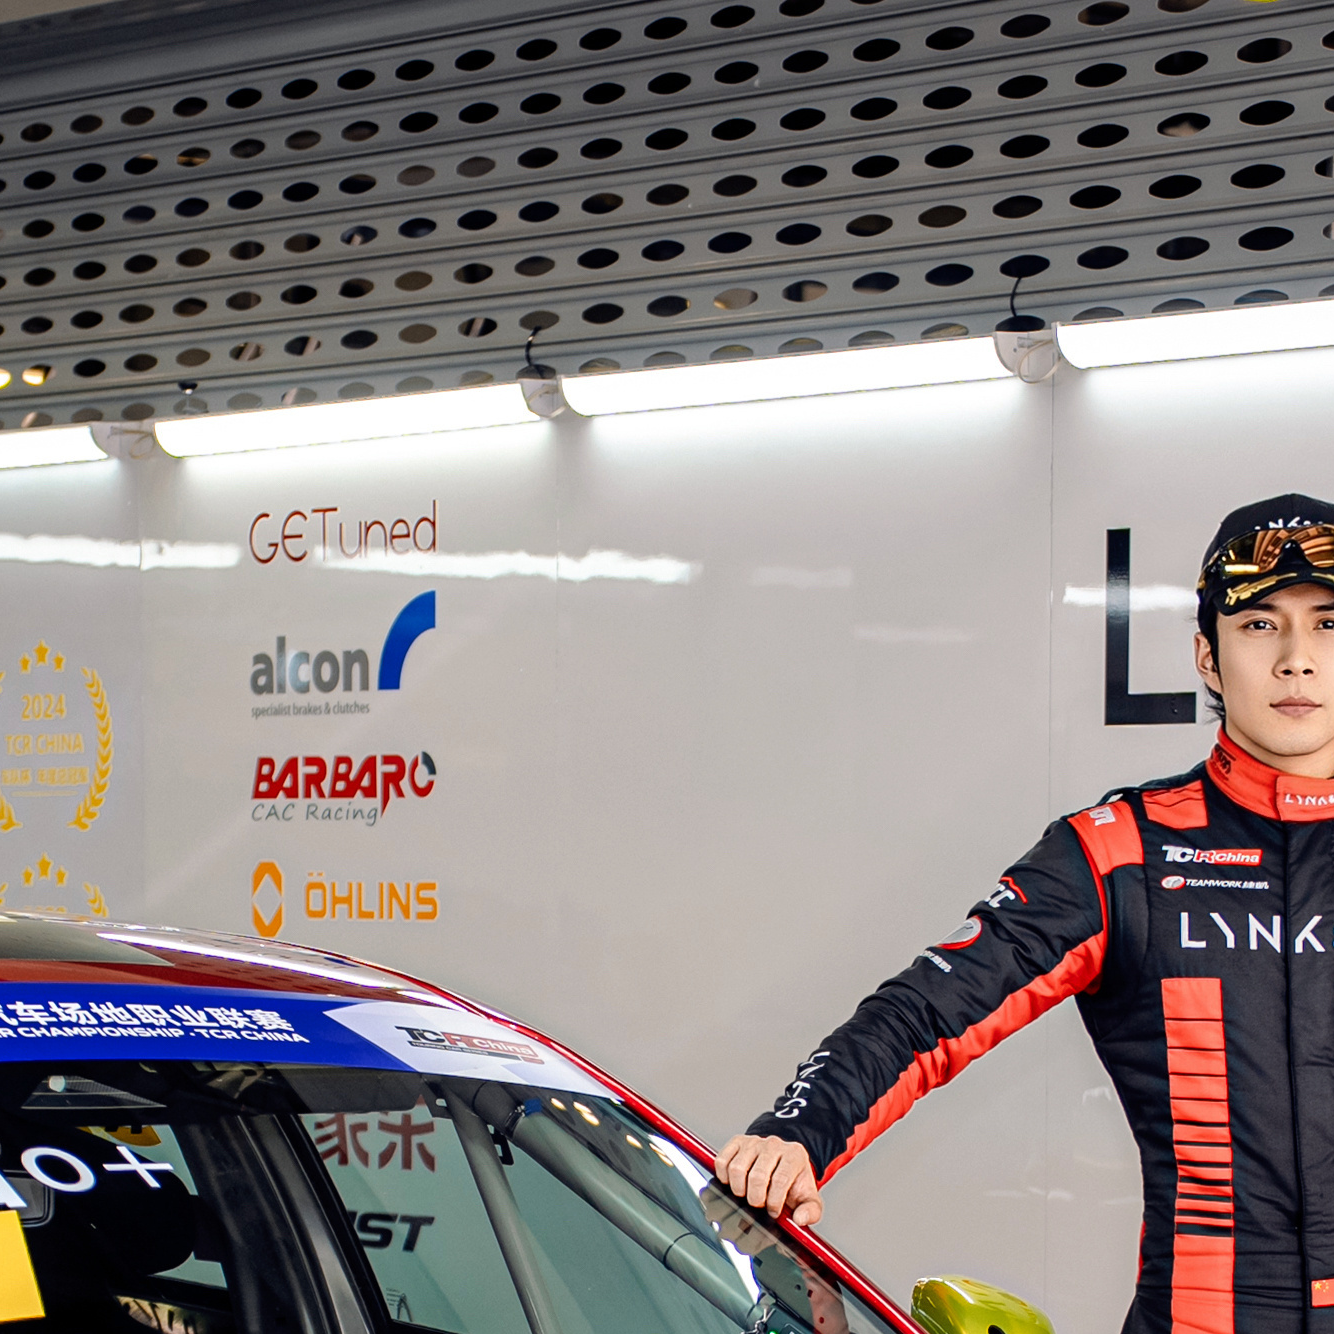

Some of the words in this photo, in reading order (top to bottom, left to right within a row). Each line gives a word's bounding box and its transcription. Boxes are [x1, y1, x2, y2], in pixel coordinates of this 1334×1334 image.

[249, 499, 437, 564] GETuned
[249, 635, 370, 696] alcon
[21, 693, 65, 721] 2024
[250, 702, 290, 719] specialist
[292, 701, 322, 716] brakes
[333, 700, 370, 715] clutches
[4, 734, 33, 757] TCR
[36, 732, 85, 755] CHINA
[251, 750, 437, 818] BARBARO
[251, 803, 296, 822] CAC
[305, 803, 379, 826] Racing
[304, 871, 438, 921] ÖHLINS
[1186, 878, 1242, 889] TEAMWORK
[17, 1026, 185, 1038] CHAMPIONSHIP
[201, 1028, 242, 1040] TCR
[240, 1030, 311, 1044] CHINA
